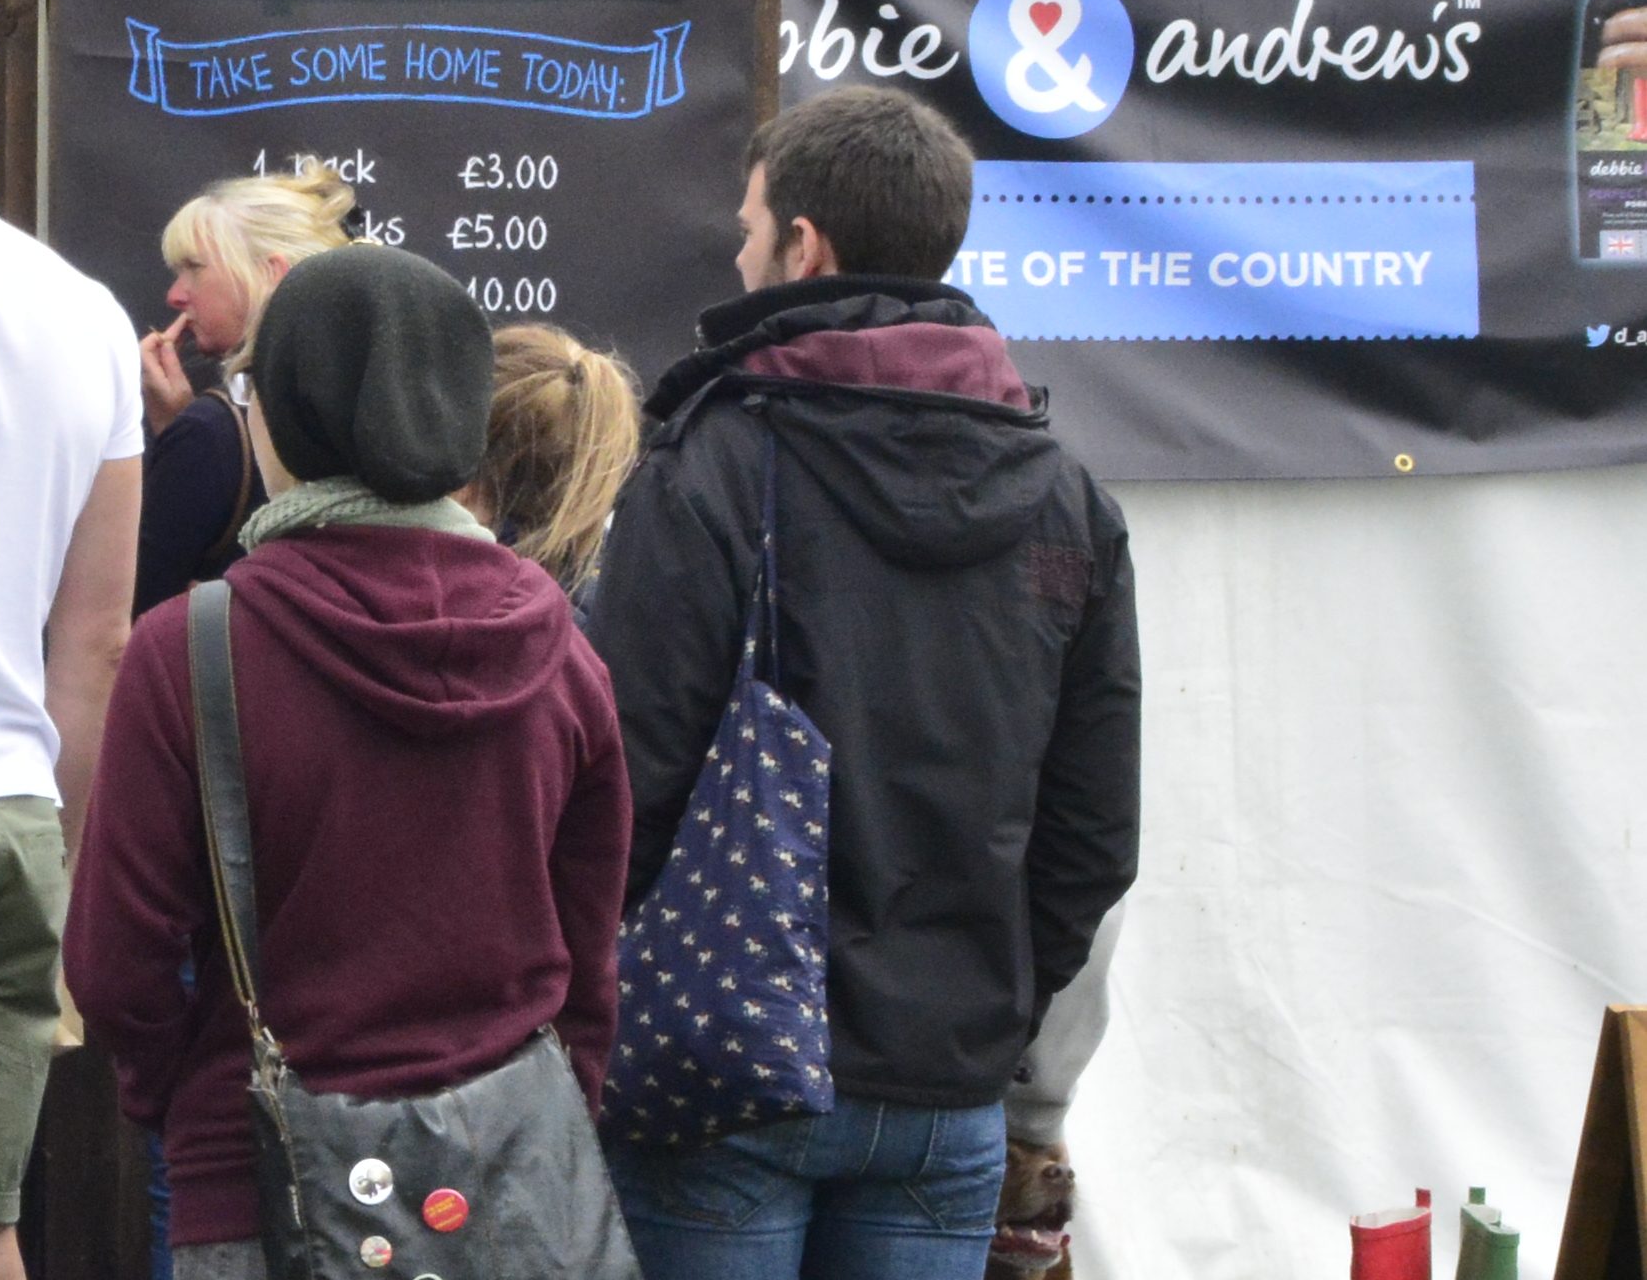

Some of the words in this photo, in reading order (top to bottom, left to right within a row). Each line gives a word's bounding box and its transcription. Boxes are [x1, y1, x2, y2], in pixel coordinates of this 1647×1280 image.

[190, 52, 273, 100] TAKE
[290, 42, 387, 86] SOME
[406, 40, 501, 89] HOME
[522, 52, 627, 110] TODAY:
[458, 153, 558, 190] £3.00
[1589, 158, 1644, 176] debbie
[446, 214, 547, 251] £5.00
[1021, 251, 1086, 288] OF
[1099, 251, 1191, 287] THE
[1208, 249, 1432, 288] COUNTRY
[467, 276, 556, 312] 10.00
